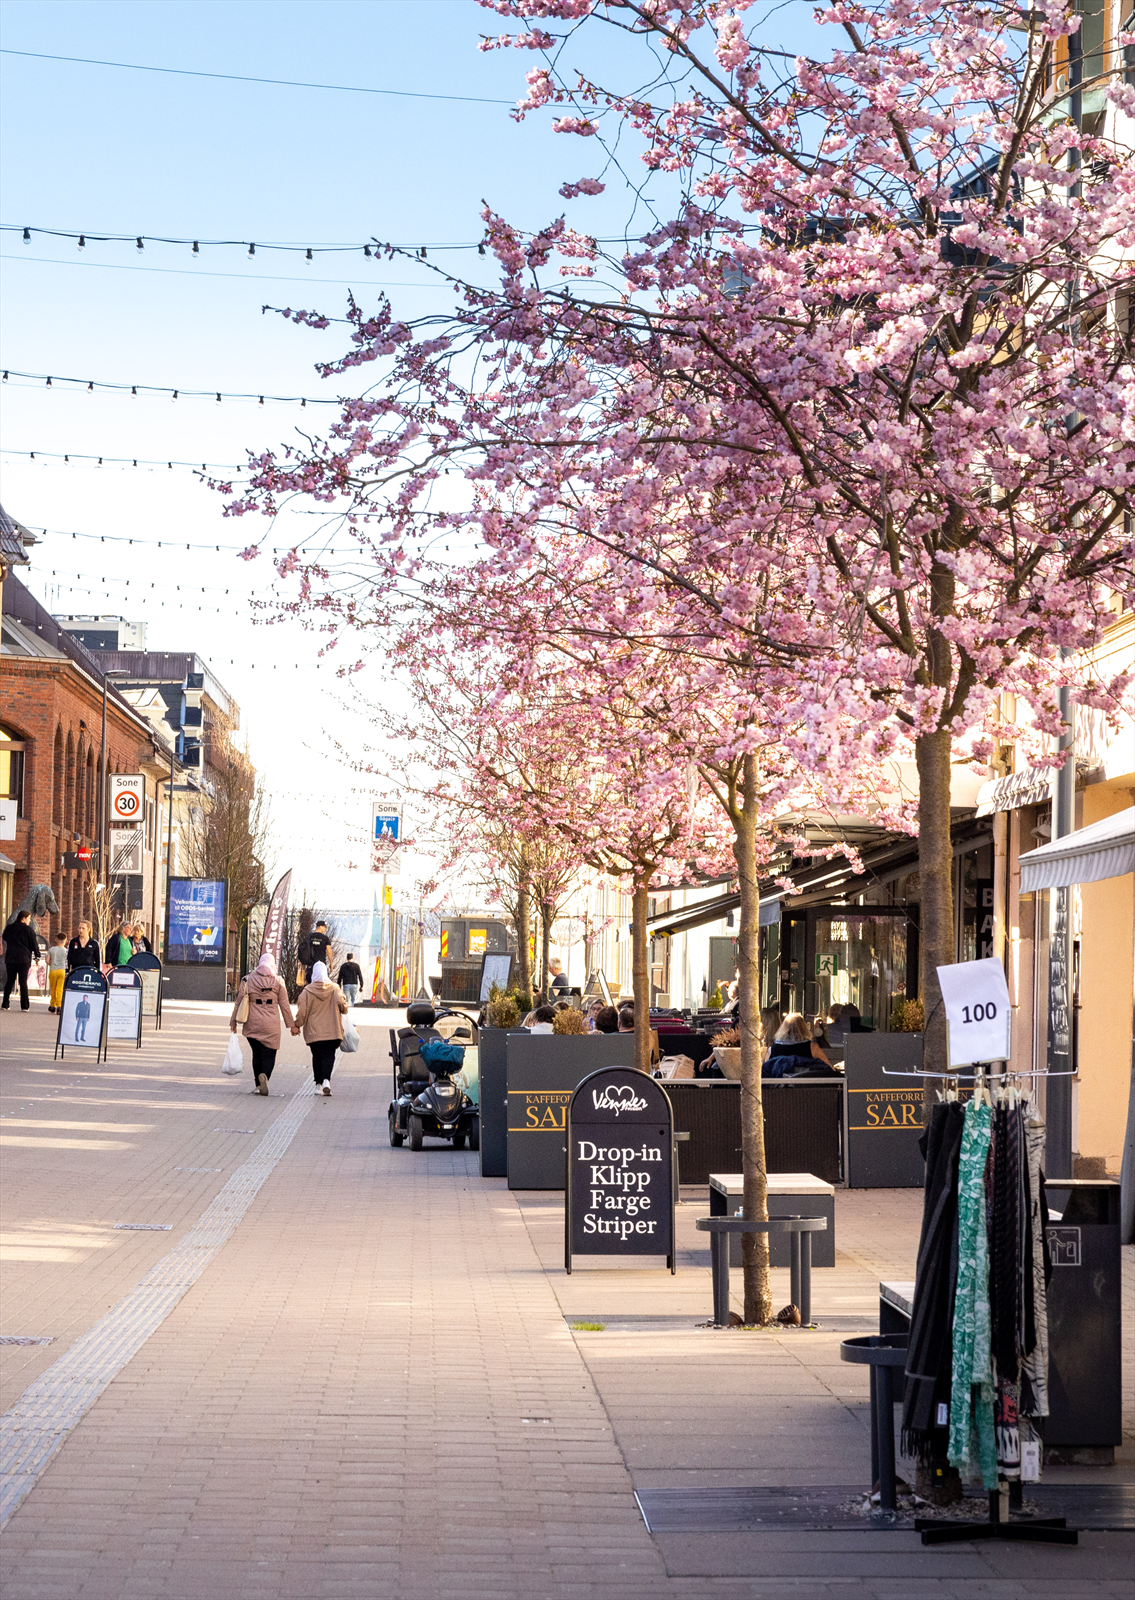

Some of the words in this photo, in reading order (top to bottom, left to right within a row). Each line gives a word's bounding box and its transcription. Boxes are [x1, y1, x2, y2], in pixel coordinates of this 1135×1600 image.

[116, 778, 138, 787] Sone
[119, 797, 136, 810] 30
[377, 804, 398, 813] Sone
[961, 1002, 998, 1024] 100
[866, 1104, 924, 1126] SAR
[578, 1141, 662, 1168] Drop-in
[590, 1165, 651, 1192] Klipp
[590, 1190, 651, 1216] Farge
[583, 1214, 657, 1240] Striper
